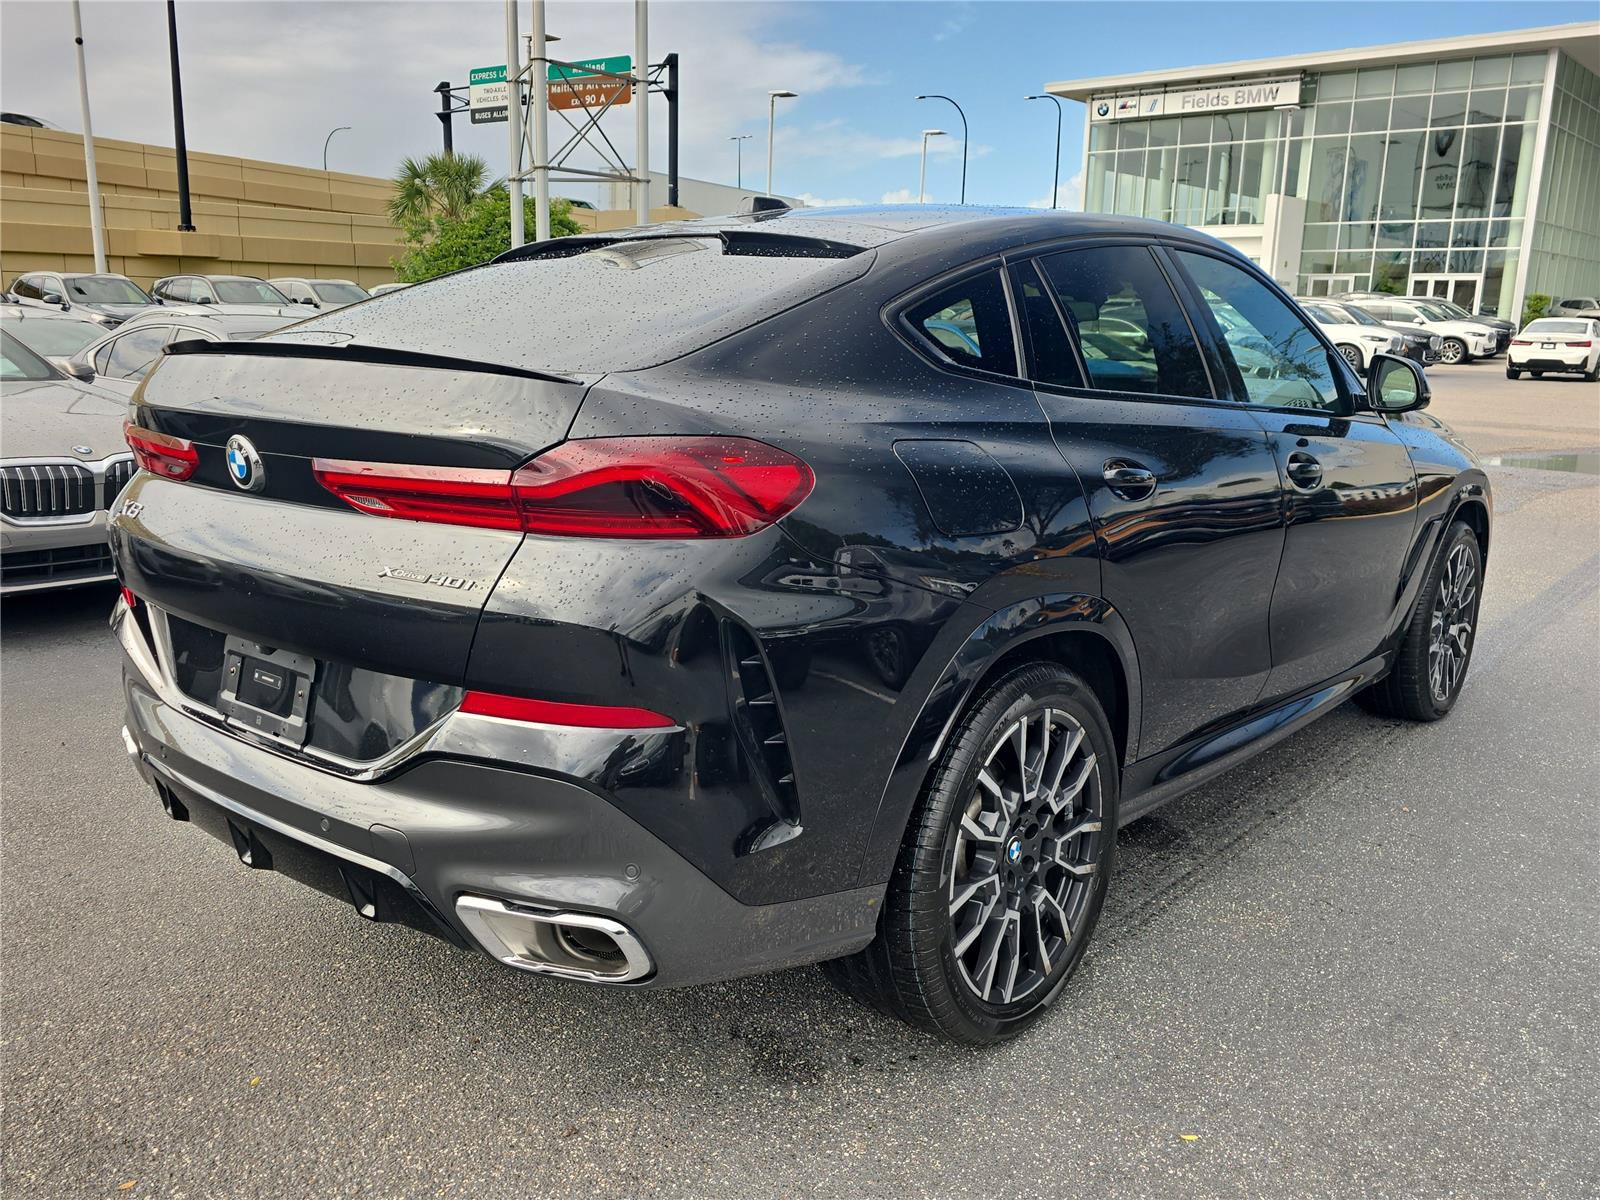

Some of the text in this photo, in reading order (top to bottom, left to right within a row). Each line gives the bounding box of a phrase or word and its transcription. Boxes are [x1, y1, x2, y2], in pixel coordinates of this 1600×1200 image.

[573, 61, 606, 74] Mtland
[471, 69, 508, 81] EXPRESS LA
[476, 95, 499, 103] VEHICLES
[585, 94, 596, 104] 90
[599, 93, 606, 103] A
[1181, 86, 1280, 109] Fields BMW
